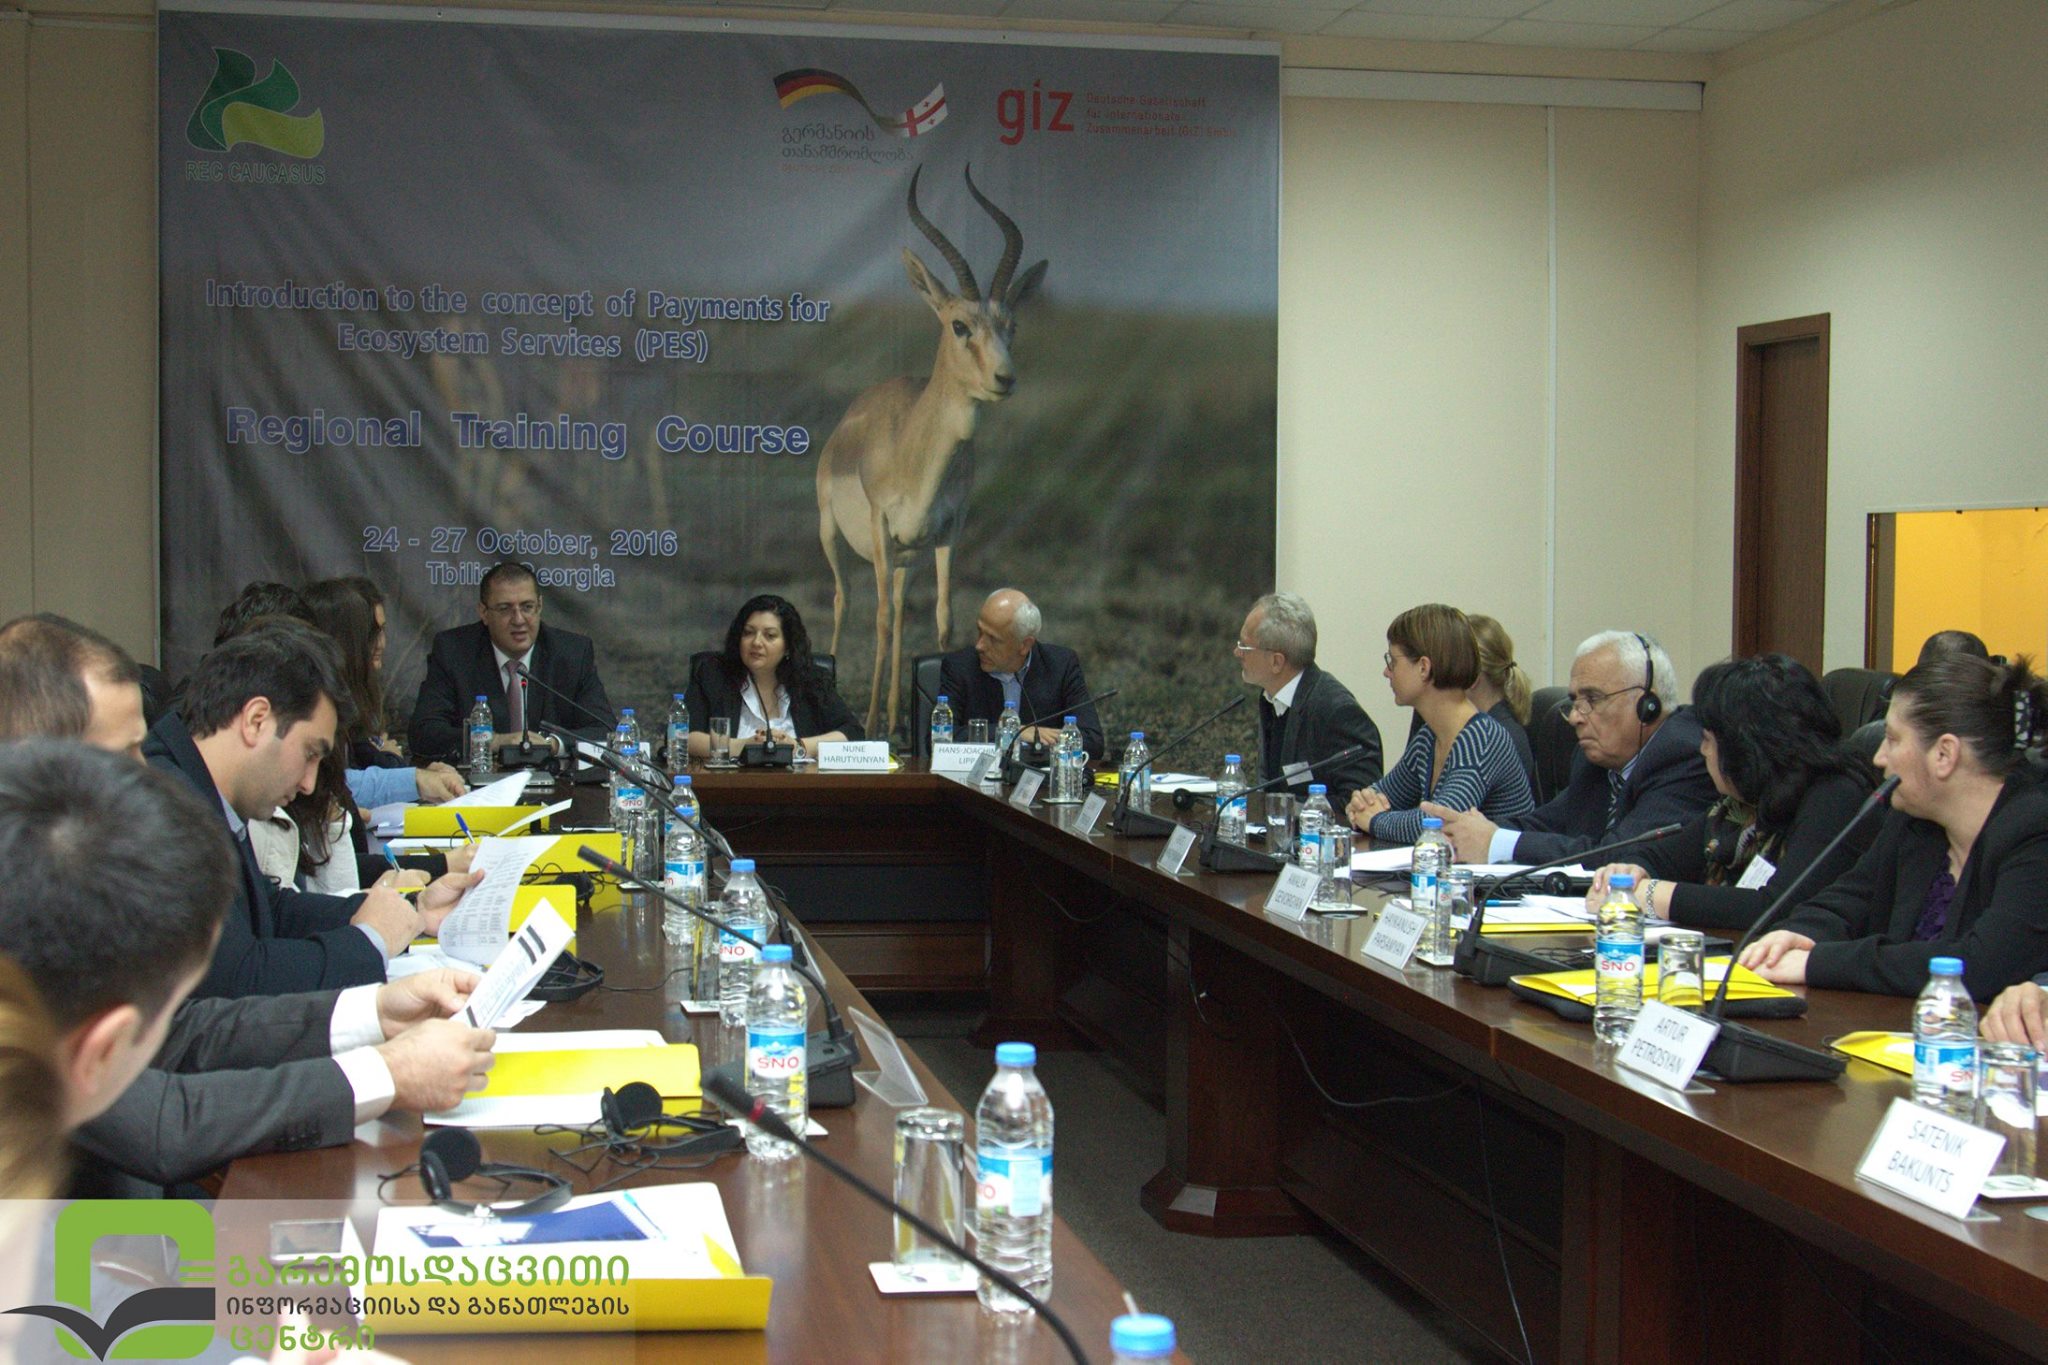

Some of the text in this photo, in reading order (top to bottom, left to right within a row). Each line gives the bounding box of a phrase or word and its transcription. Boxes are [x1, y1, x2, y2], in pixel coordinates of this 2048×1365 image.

[997, 78, 1074, 146] giz
[185, 160, 326, 185] REC CAUCASUS
[206, 279, 830, 326] Introduction to the concept of Payments for
[337, 323, 709, 363] Ecosystem Services (PES)
[226, 406, 810, 460] Regional Training Course
[363, 526, 400, 552] 24
[431, 527, 466, 553] 27
[476, 528, 598, 559] October,
[610, 529, 678, 556] 2016
[520, 562, 615, 591] eorgia
[823, 755, 885, 764] HARUTYUNYAN
[1601, 960, 1636, 972] SNO
[1653, 1016, 1689, 1042] ARTUR
[758, 1056, 799, 1069] SNO
[1630, 1038, 1685, 1075] PETROSYAN
[1907, 1120, 1968, 1158] SATENIK
[1887, 1150, 1954, 1193] BAKUNTS
